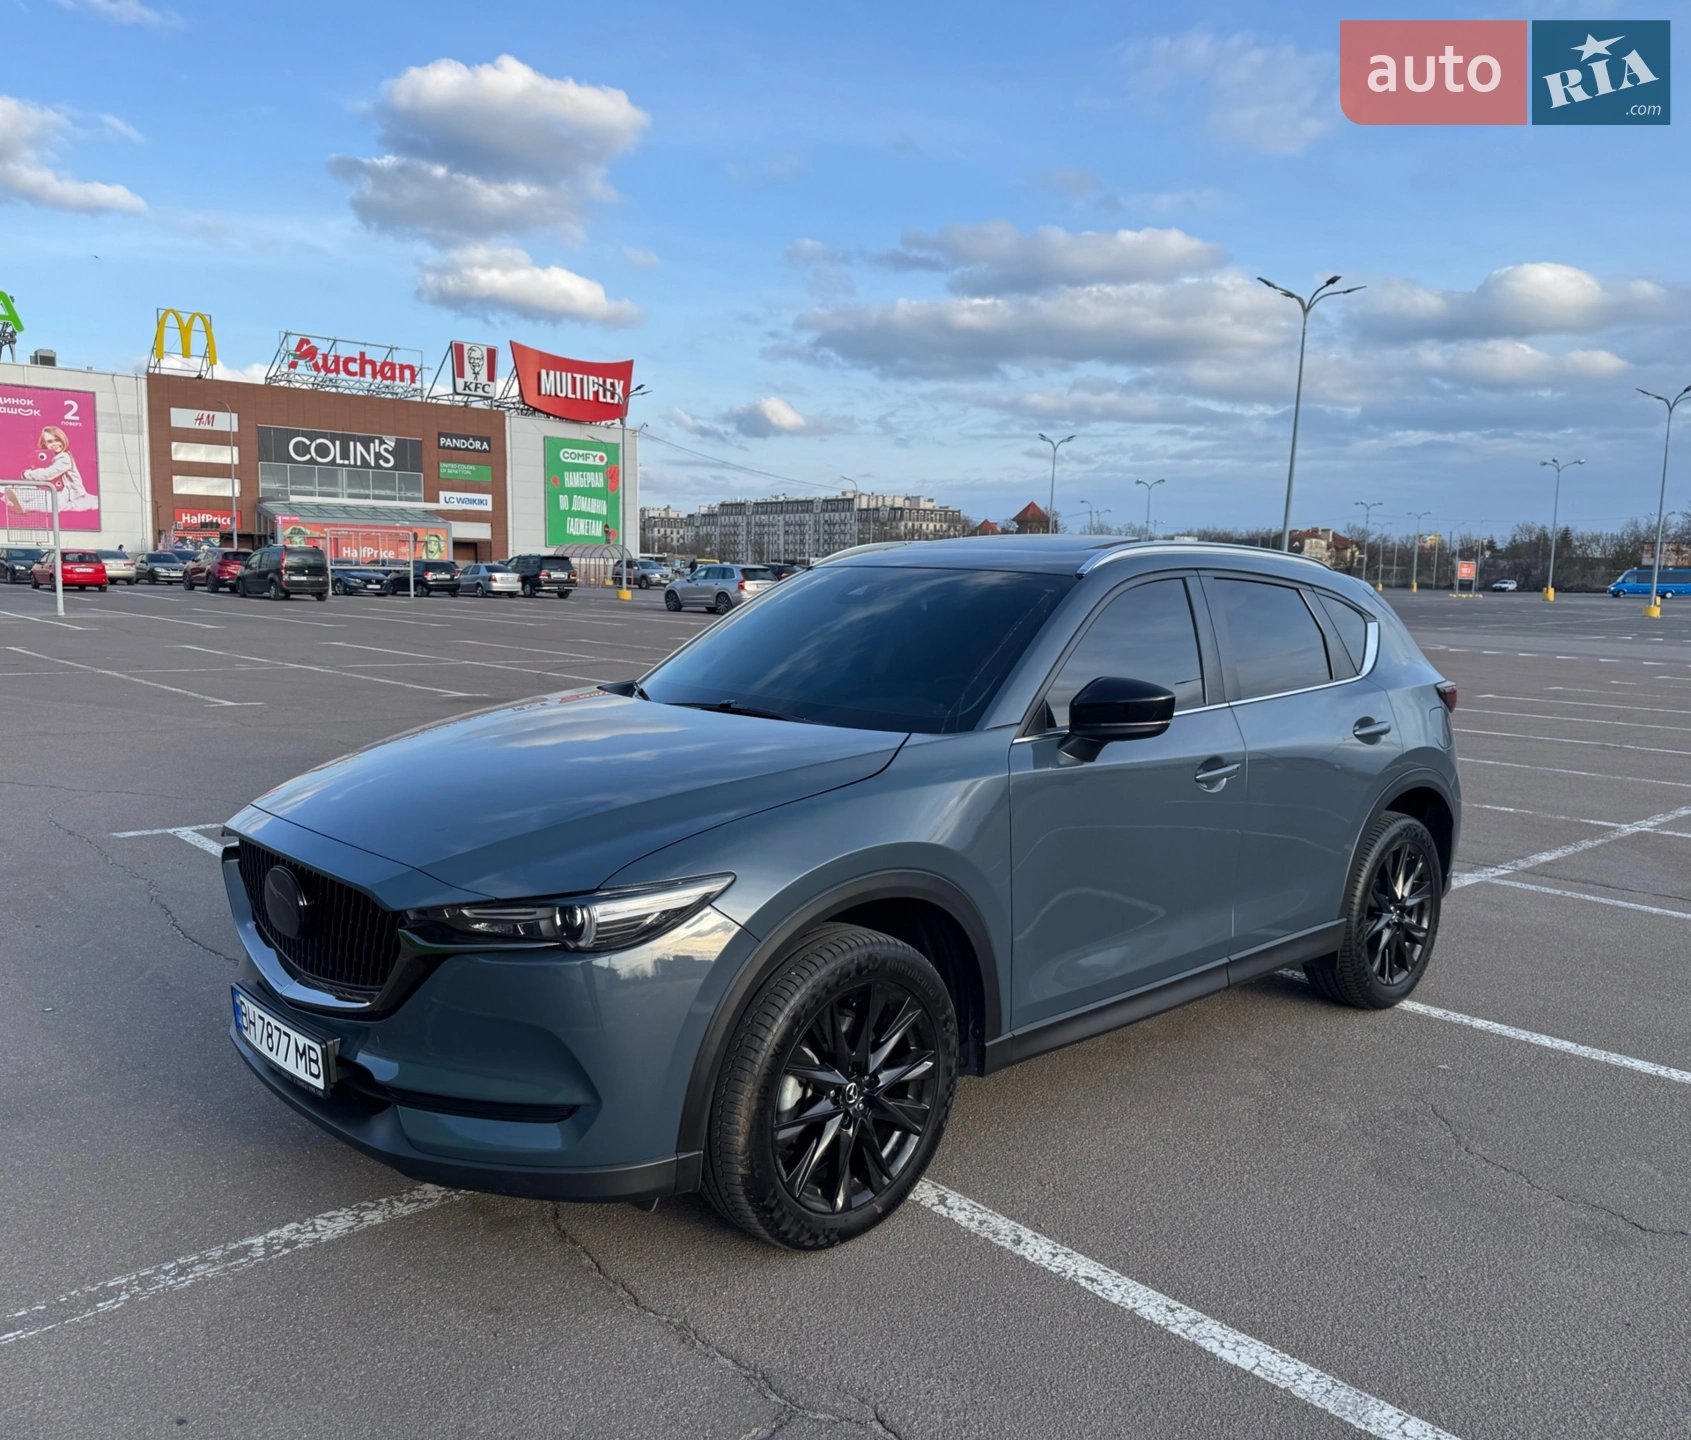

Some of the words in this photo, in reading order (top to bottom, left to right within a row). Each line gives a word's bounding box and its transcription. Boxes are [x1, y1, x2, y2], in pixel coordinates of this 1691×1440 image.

[288, 338, 416, 384] Auchan
[462, 381, 491, 394] KFC
[538, 369, 624, 405] MULTIPLEX
[64, 400, 79, 420] 2
[194, 412, 215, 427] H&M
[289, 436, 395, 468] COLIN'S
[440, 437, 489, 451] PANDORA
[562, 451, 598, 462] COMFY
[564, 471, 604, 488] НАМБЕРВАН
[444, 496, 455, 504] LC
[559, 494, 569, 510] ПО
[566, 517, 602, 537] ГАДЖЕТАМ
[342, 546, 396, 559] HalfPrice
[257, 1014, 292, 1062] 7877
[294, 1037, 322, 1080] MB
